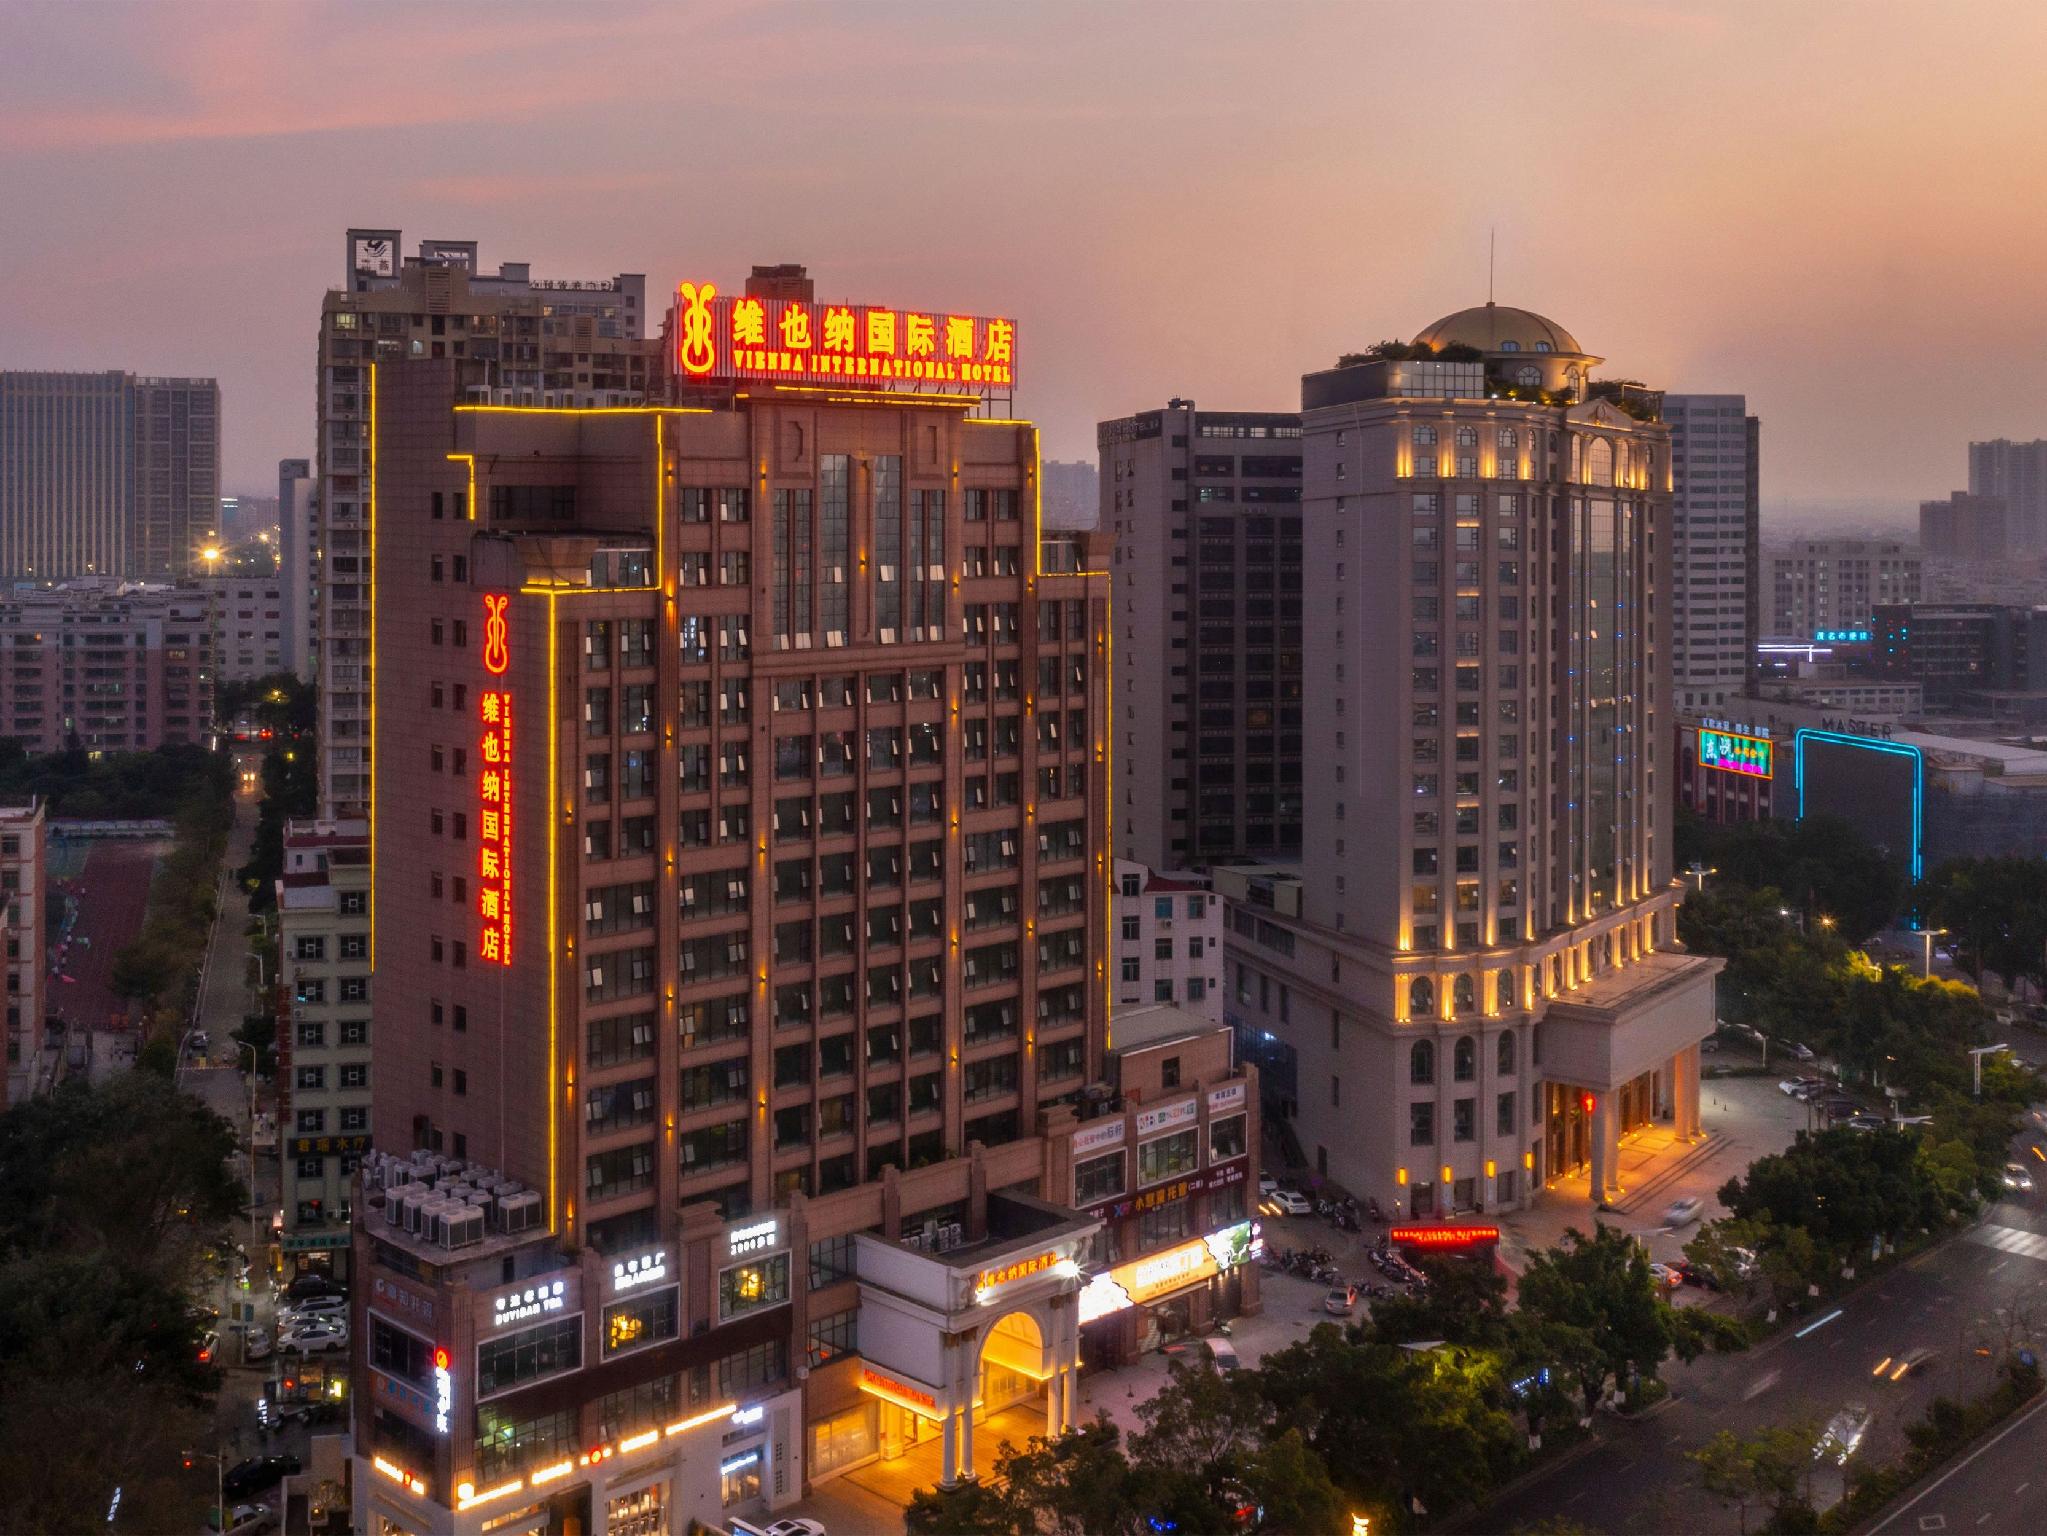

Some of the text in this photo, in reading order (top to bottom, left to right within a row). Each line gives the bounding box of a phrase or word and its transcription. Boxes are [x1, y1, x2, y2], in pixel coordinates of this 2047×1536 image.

[733, 299, 1013, 362] 维也纳国际酒店
[734, 350, 1012, 383] VIENNA INTERNATIONAL HOTEL
[1822, 717, 1892, 740] MASTER
[481, 693, 500, 960] 维也纳国际酒店
[503, 694, 511, 966] VIENNA INTERNATIONAL HOTEL
